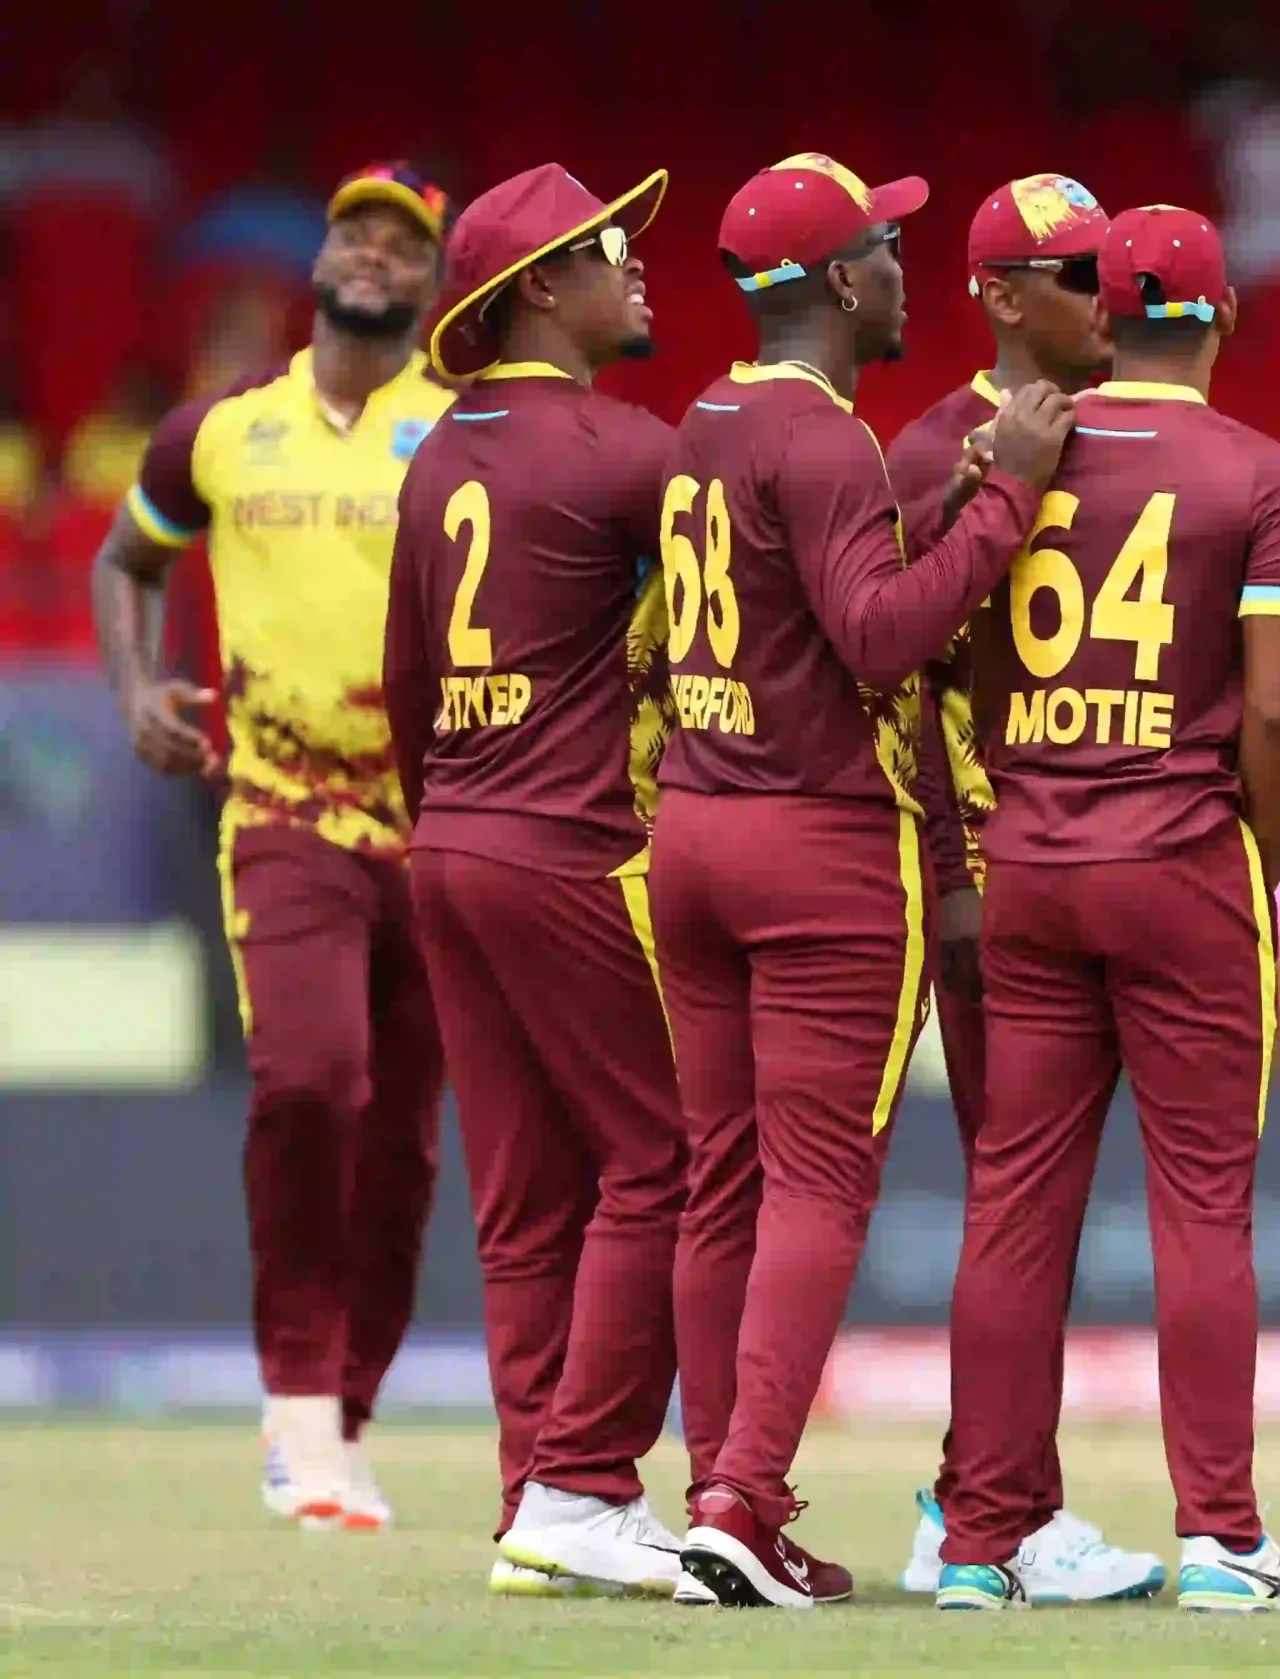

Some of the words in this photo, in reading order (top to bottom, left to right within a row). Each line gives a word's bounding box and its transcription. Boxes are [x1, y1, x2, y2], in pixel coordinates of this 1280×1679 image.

[233, 491, 321, 530] WEST
[444, 481, 492, 666] 2
[660, 475, 740, 667] 68
[1010, 490, 1176, 681] 64
[1005, 687, 1174, 748] MOTIE
